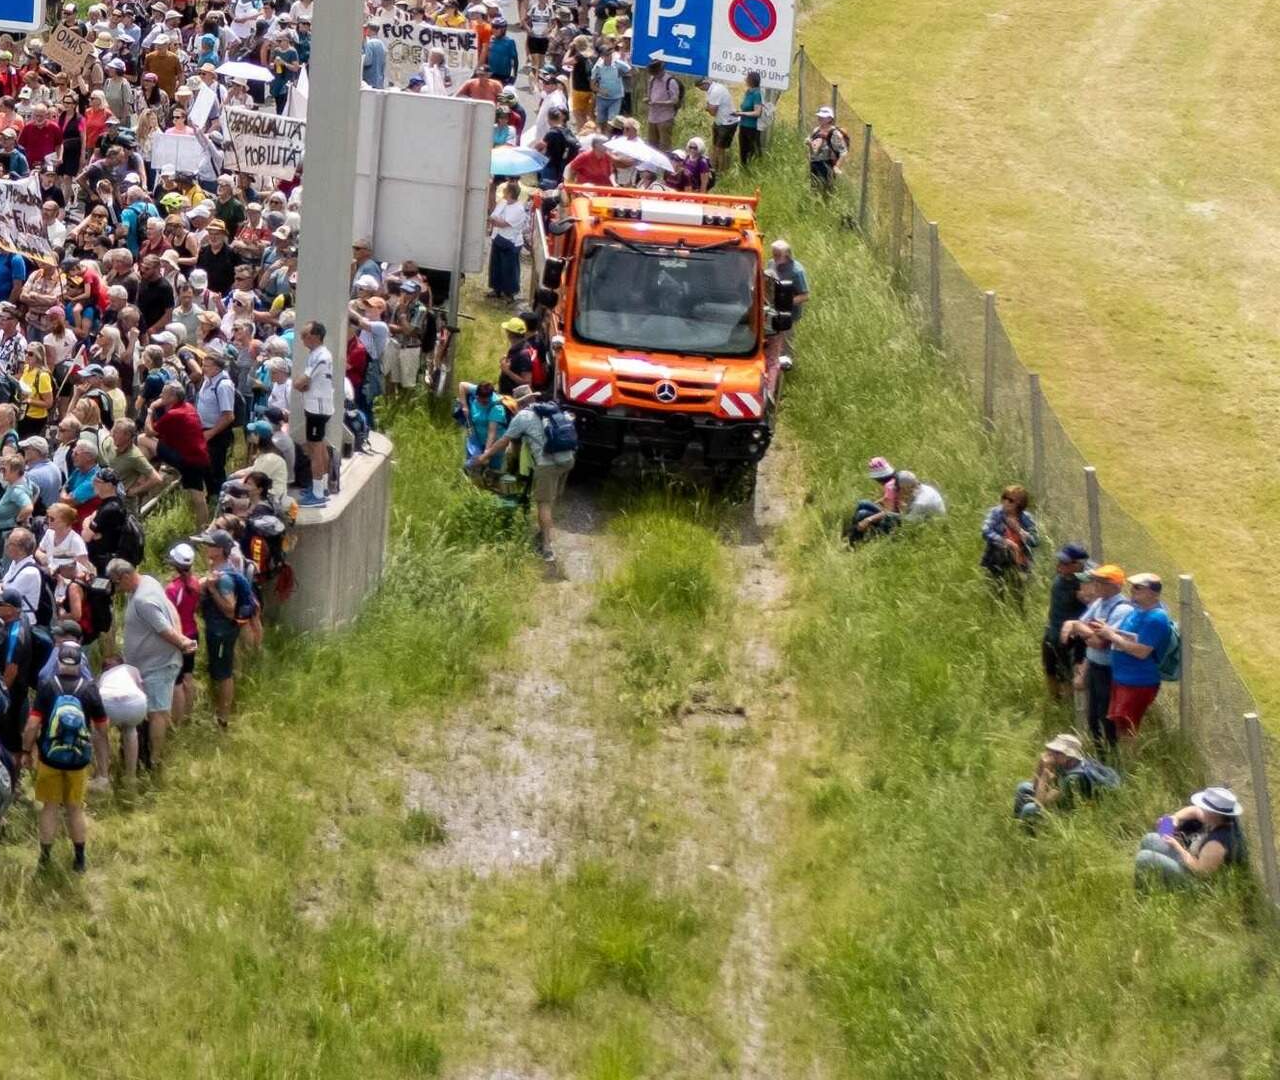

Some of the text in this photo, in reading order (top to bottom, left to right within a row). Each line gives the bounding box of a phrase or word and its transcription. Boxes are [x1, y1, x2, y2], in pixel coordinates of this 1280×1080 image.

[57, 30, 86, 55] OMAS
[382, 21, 477, 51] FÜR OFFENE
[768, 69, 785, 82] Uhr
